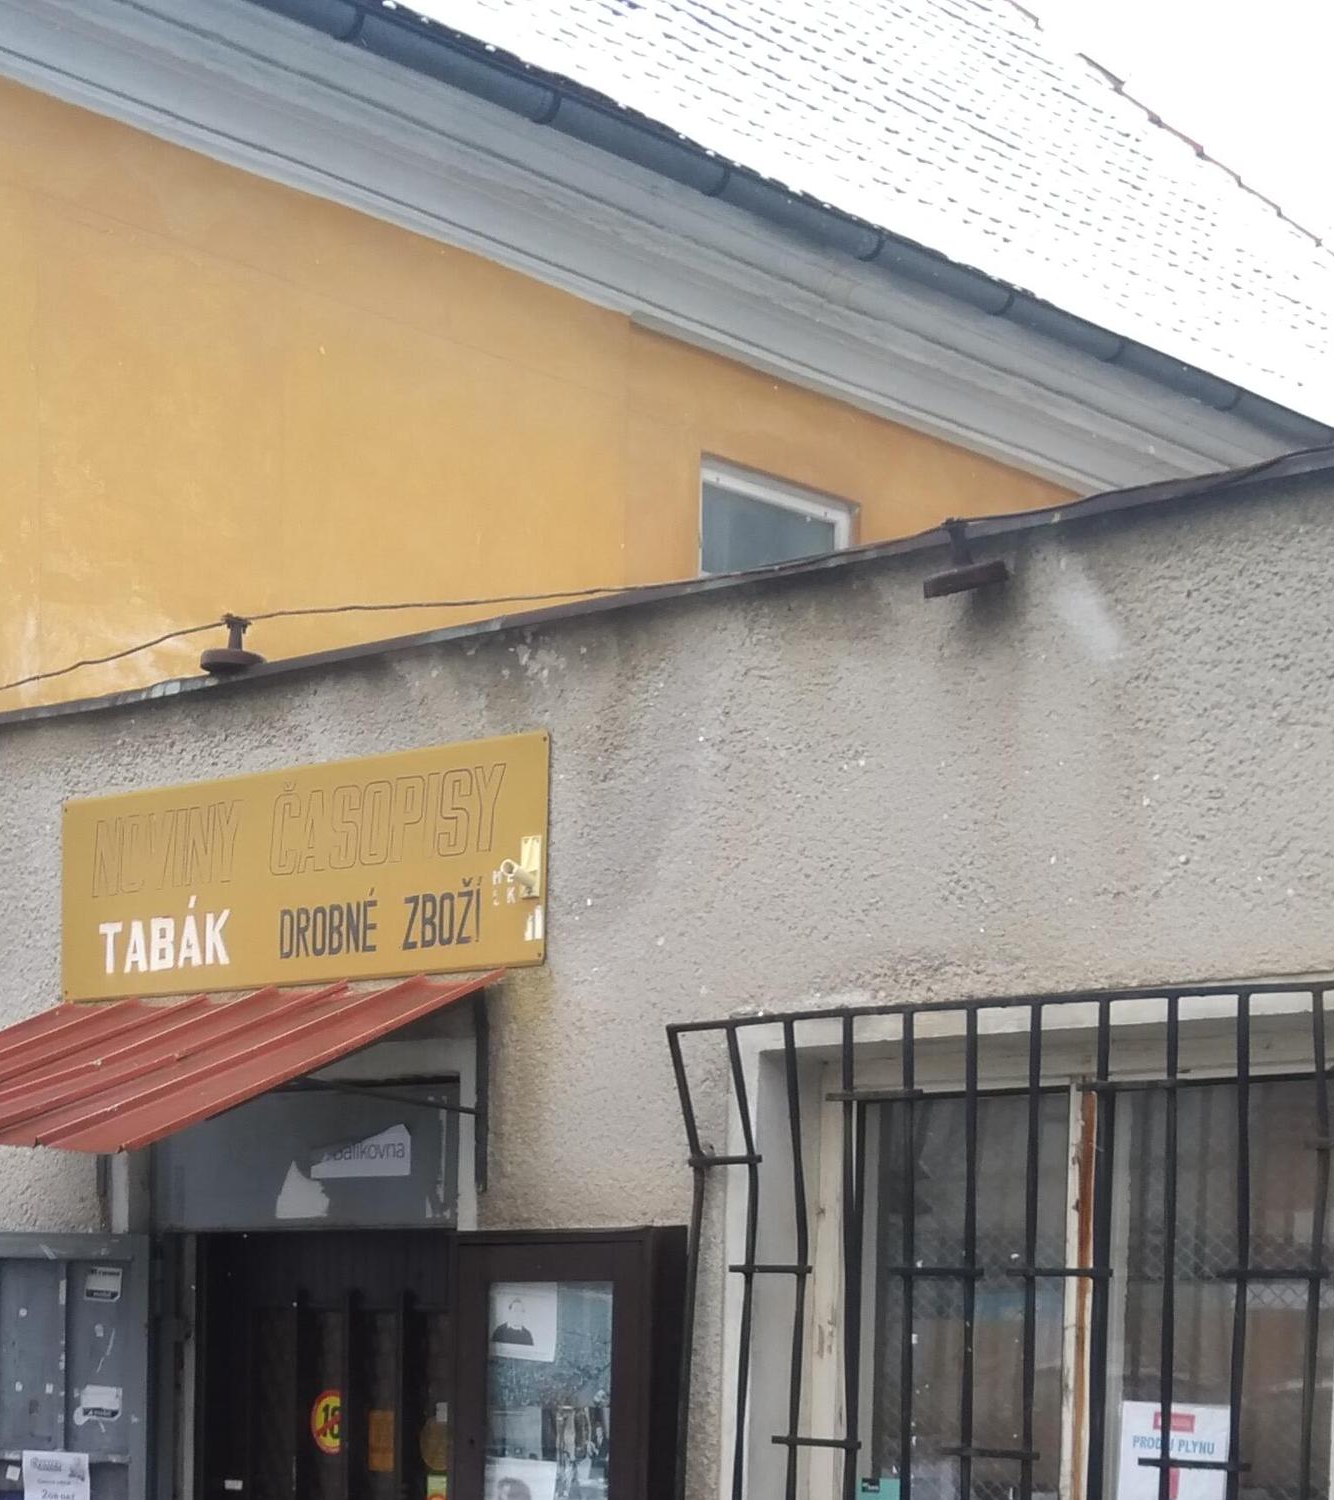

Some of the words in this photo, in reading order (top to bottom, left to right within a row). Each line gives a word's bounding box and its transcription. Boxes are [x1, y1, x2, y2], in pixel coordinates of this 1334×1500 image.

[91, 799, 244, 898] NOVINY
[269, 764, 506, 876] ČASOPISY
[99, 895, 231, 974] TABÁK
[280, 887, 378, 960] DROBNÉ
[402, 876, 482, 951] ZBOŽÍ
[1132, 1435, 1174, 1451] PRODJ
[1178, 1439, 1215, 1455] PLYNU
